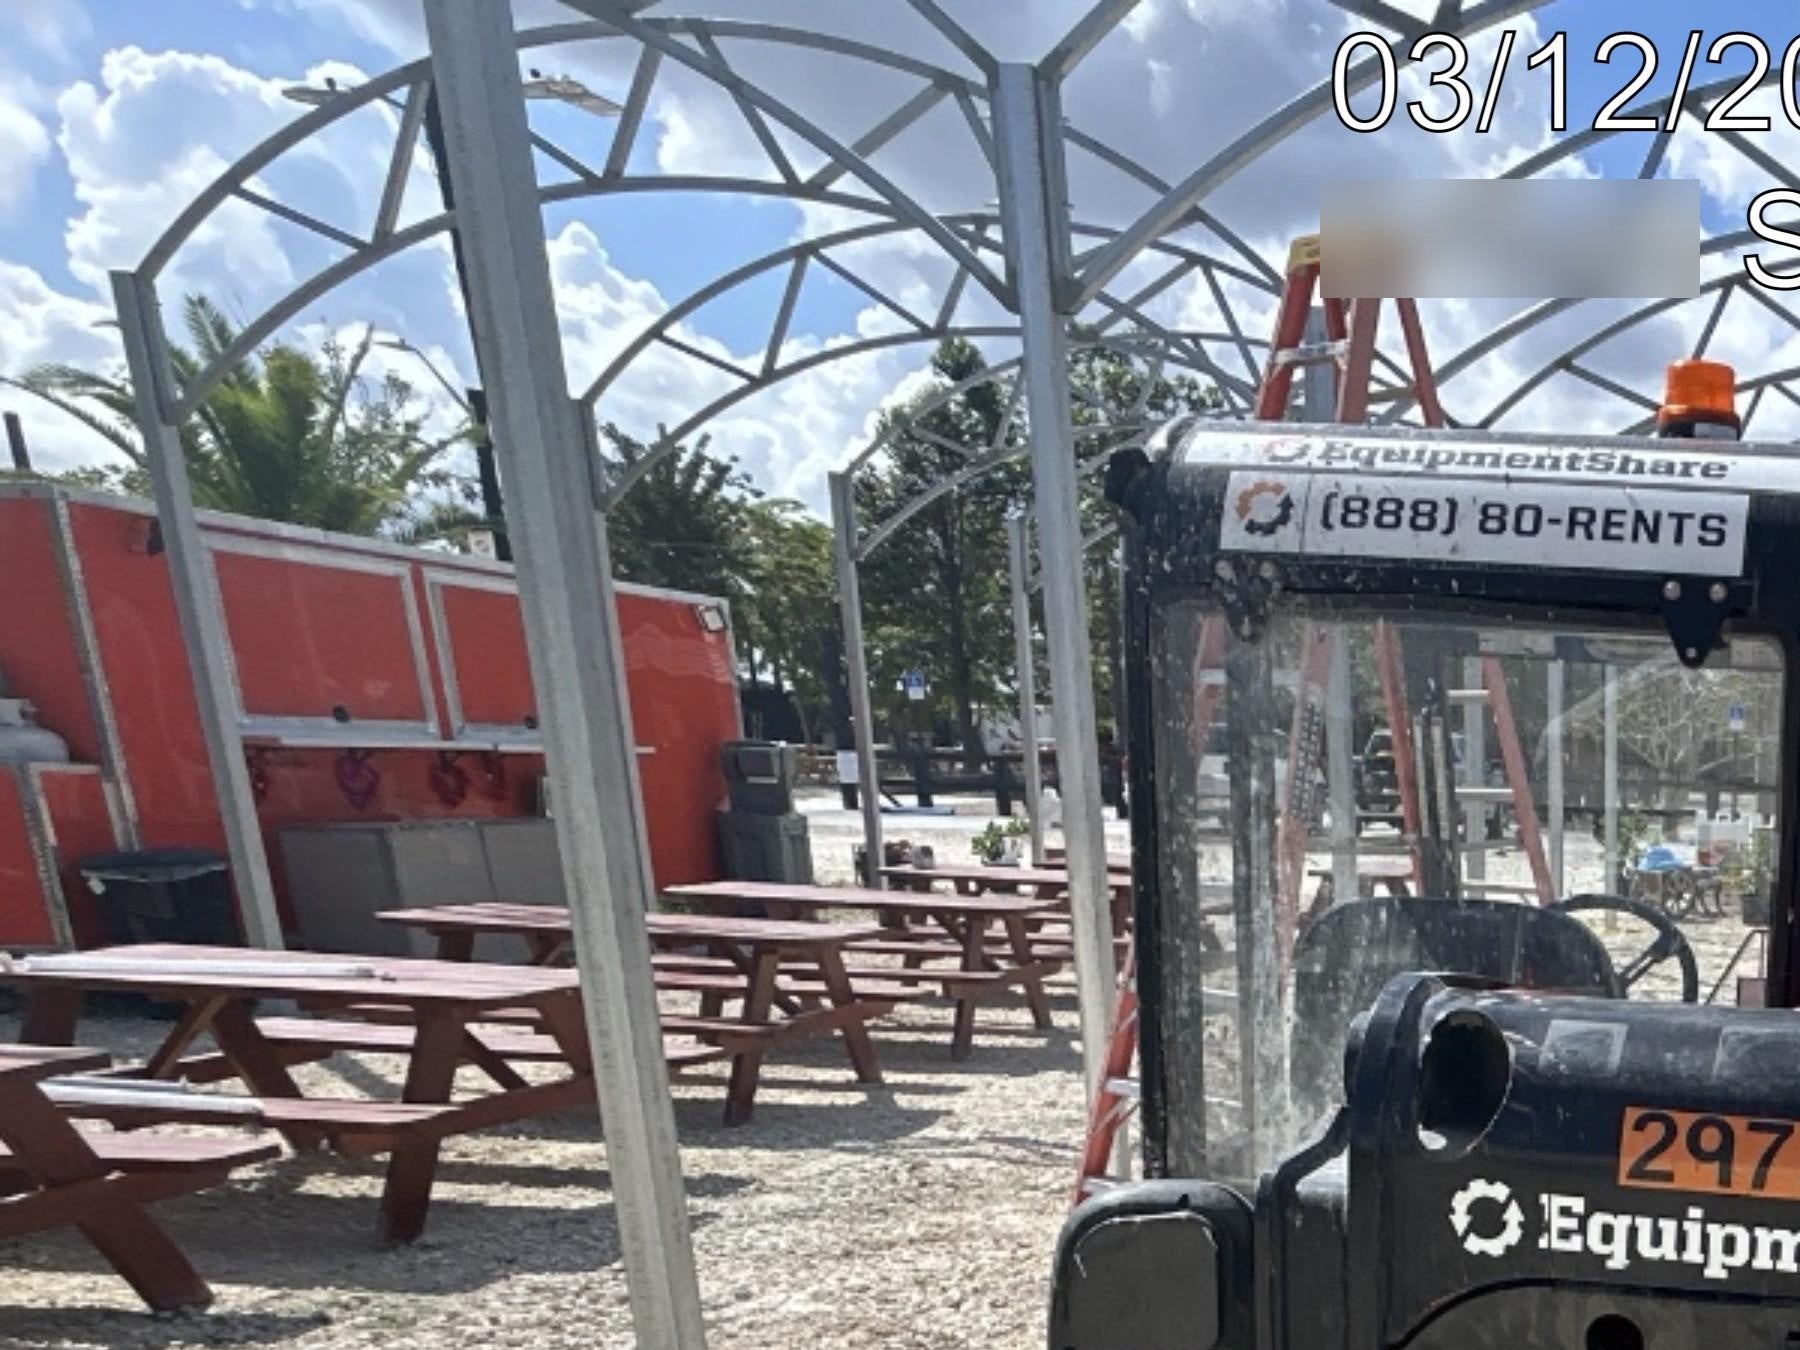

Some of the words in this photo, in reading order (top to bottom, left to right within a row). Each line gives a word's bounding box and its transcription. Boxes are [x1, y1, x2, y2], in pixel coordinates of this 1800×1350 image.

[1318, 438, 1732, 482] EquipmentShare
[1321, 491, 1457, 535] (888)
[1477, 500, 1728, 548] 80-RENTS
